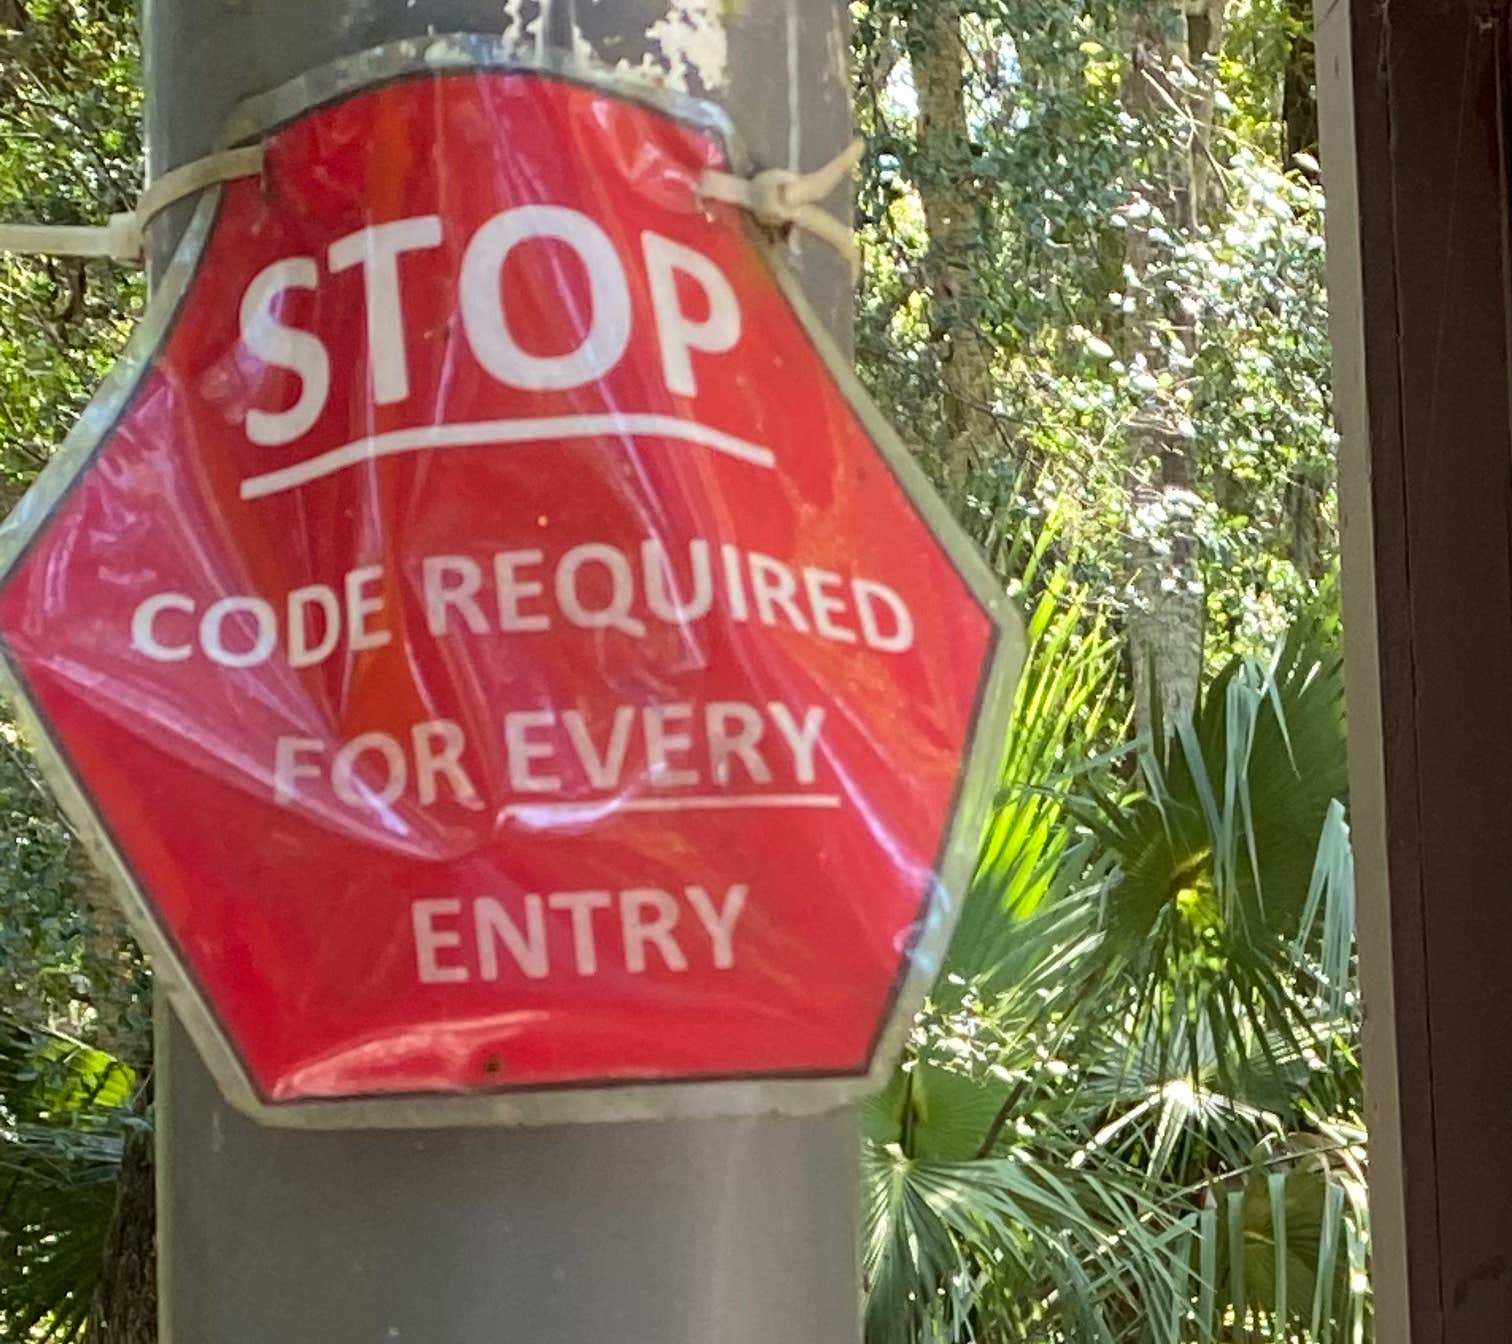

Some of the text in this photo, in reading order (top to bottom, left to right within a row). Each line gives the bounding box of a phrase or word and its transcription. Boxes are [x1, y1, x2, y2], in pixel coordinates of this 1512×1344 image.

[238, 205, 742, 447] STOP
[129, 539, 914, 668] CODE REQUIRED
[273, 702, 826, 811] FOR EVERY
[412, 885, 748, 983] ENTRY
